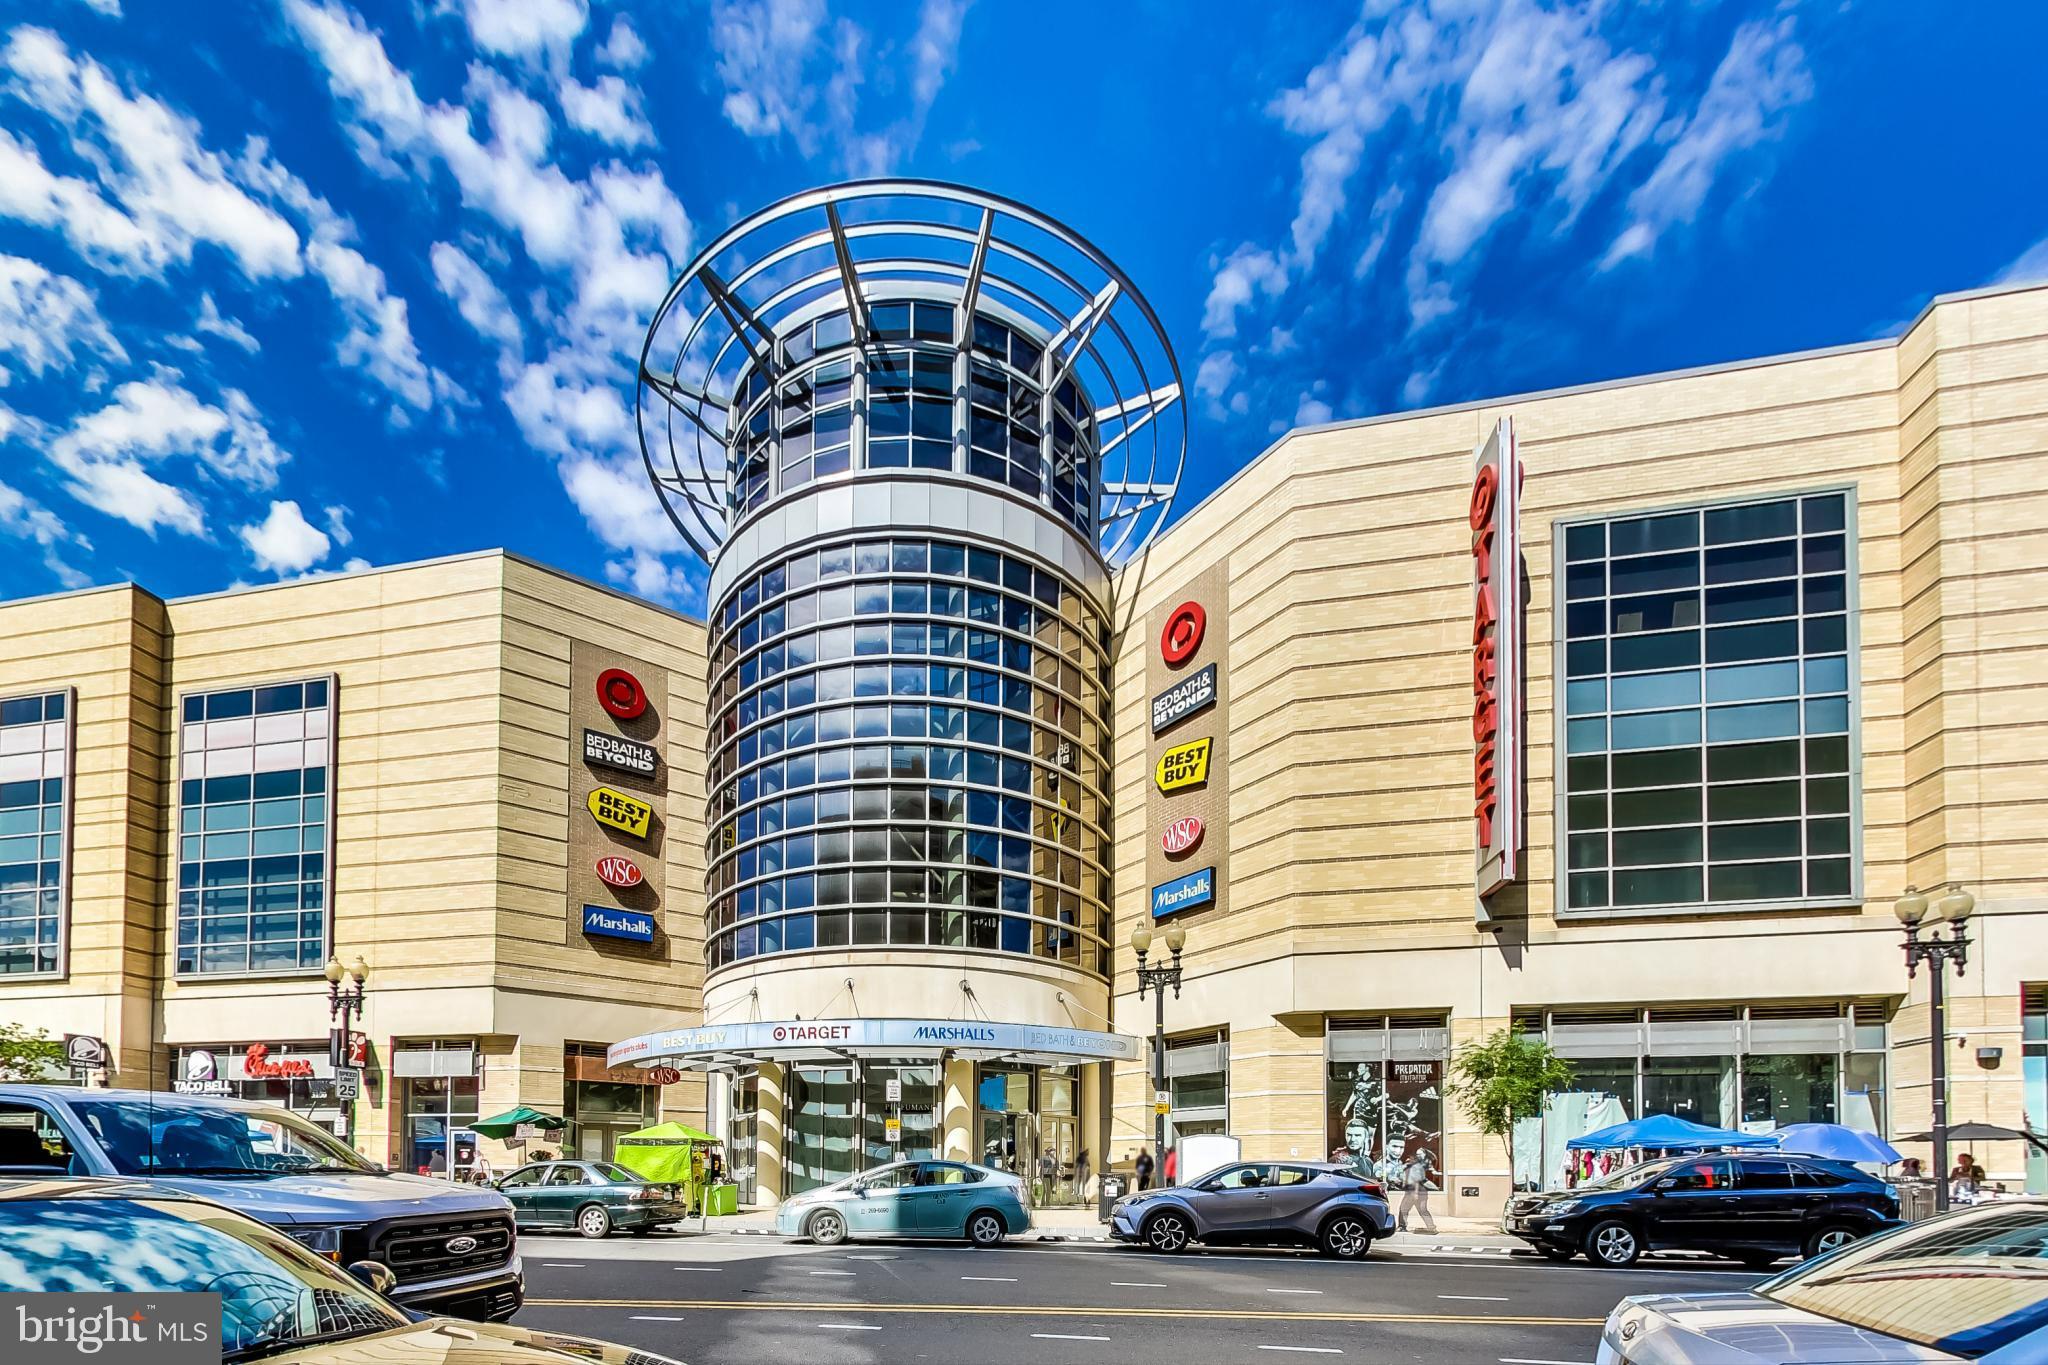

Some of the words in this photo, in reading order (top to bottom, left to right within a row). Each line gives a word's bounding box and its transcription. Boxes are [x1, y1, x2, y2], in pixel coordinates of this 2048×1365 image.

[1153, 694, 1173, 716] BED
[1173, 677, 1200, 703] BATH
[1201, 672, 1211, 687] &
[1472, 523, 1497, 848] TARGET
[1153, 687, 1212, 727] BEYOND
[586, 733, 611, 750] BED
[611, 739, 643, 760] BATH
[643, 749, 654, 763] &
[586, 746, 655, 772] BEYOND
[1163, 746, 1206, 769] BEST
[1164, 763, 1200, 784] BUY
[598, 791, 648, 820] BEST
[598, 806, 642, 829] BUY
[1165, 818, 1196, 850] WSC
[601, 858, 637, 884] WSC
[1154, 878, 1210, 910] Marshalls
[586, 912, 652, 935] Marshalls
[663, 1032, 693, 1048] BEST
[696, 1031, 728, 1045] BUY
[788, 1025, 851, 1040] TARGET
[912, 1026, 995, 1041] MARSHALLS
[1030, 1032, 1047, 1045] BED
[1048, 1034, 1069, 1046] BATH
[1069, 1036, 1075, 1047] &
[1077, 1037, 1127, 1051] BEYOND
[657, 1068, 677, 1083] WSC
[1395, 1064, 1433, 1075] PREDATOR
[173, 1080, 203, 1093] TACO
[204, 1080, 233, 1093] BELL
[340, 1084, 356, 1097] 25
